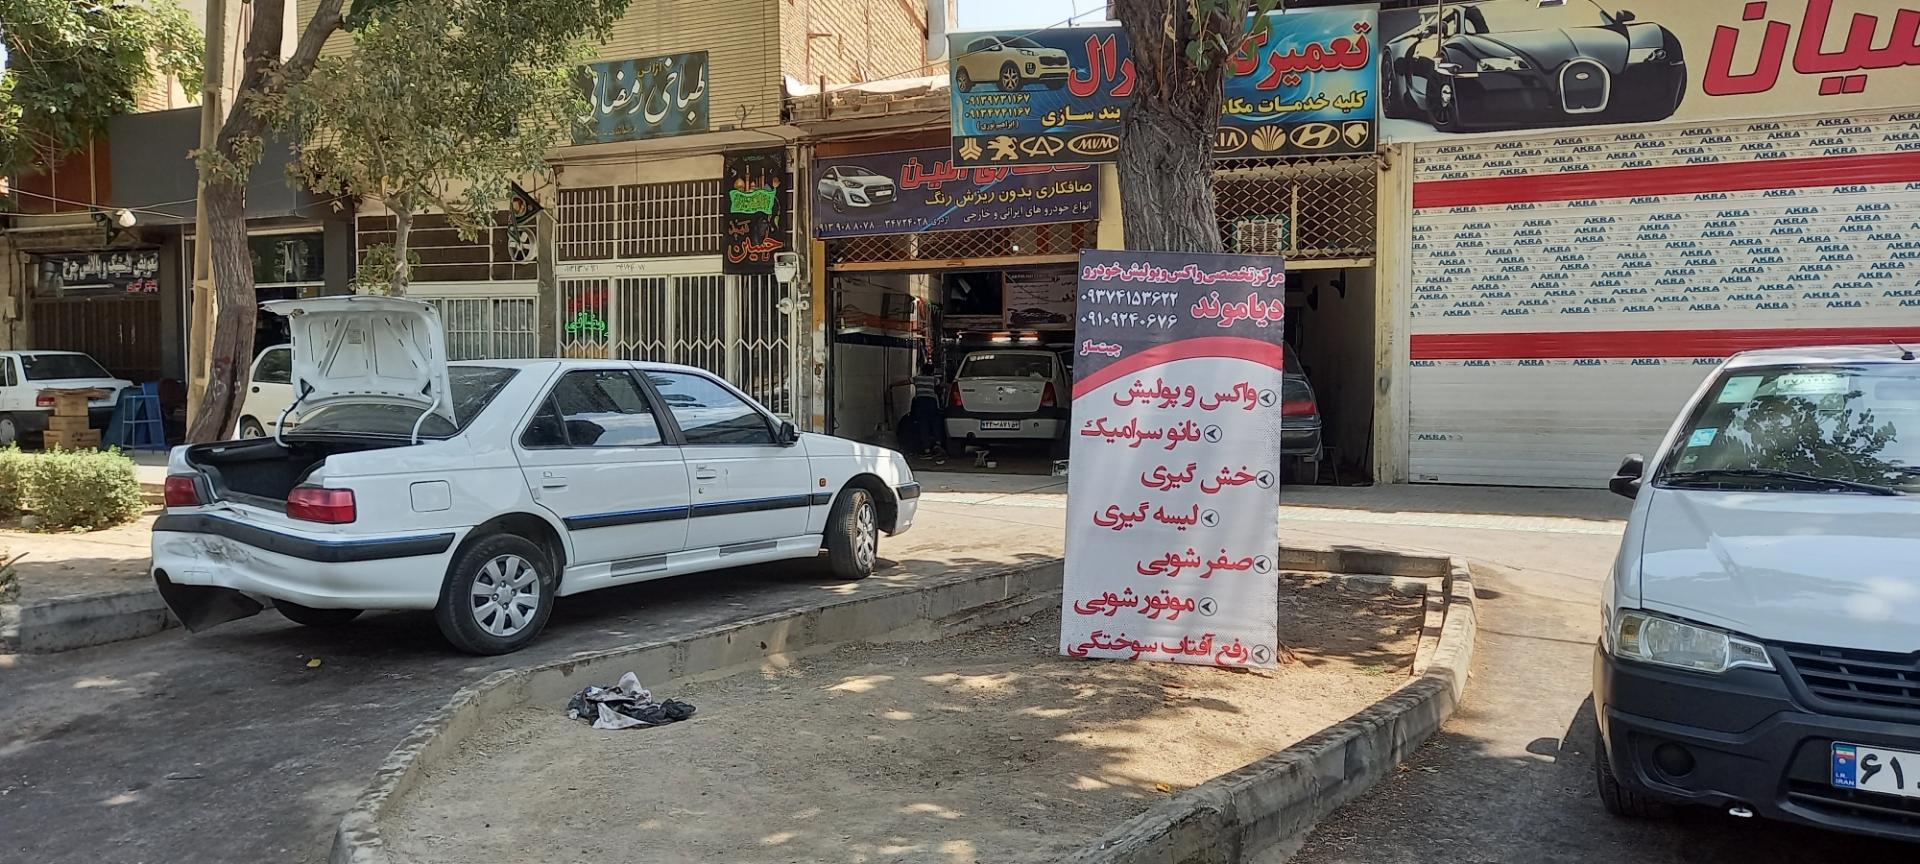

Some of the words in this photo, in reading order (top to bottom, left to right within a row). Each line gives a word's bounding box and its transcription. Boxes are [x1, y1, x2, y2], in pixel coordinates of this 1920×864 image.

[644, 57, 706, 125] طباخی
[1258, 91, 1329, 113] خدمات
[1333, 90, 1367, 113] کلیه
[1041, 105, 1094, 128] سازی
[1494, 142, 1524, 150] AKRA
[1615, 133, 1645, 141] AKRA
[1748, 123, 1780, 131] AKRA
[1816, 118, 1851, 127] AKRA
[1513, 149, 1542, 157] AKRA
[1767, 131, 1800, 140] AKRA
[1837, 126, 1872, 135] AKRA
[1078, 139, 1114, 151] MVM
[1483, 160, 1512, 168] AKRA
[1543, 156, 1574, 164] AKRA
[1740, 142, 1773, 151] AKRA
[1809, 138, 1844, 147] AKRA
[1882, 133, 1920, 142] AKRA
[1560, 164, 1589, 172] AKRA
[1754, 151, 1787, 160] AKRA
[1823, 147, 1858, 156] AKRA
[925, 191, 953, 207] رنگ
[956, 189, 995, 208] ریزش
[998, 187, 1032, 204] بدون
[1036, 180, 1092, 199] صافکاری
[1506, 203, 1535, 211] AKRA
[1763, 189, 1796, 197] AKRA
[1832, 186, 1867, 194] AKRA
[963, 208, 991, 223] خارجی
[999, 206, 1023, 220] ایرانی
[1025, 204, 1042, 218] های
[1044, 205, 1069, 217] خودرو
[1072, 201, 1092, 215] انواع
[1717, 209, 1750, 218] AKRA
[1785, 206, 1818, 215] AKRA
[1856, 203, 1891, 212] AKRA
[1774, 217, 1809, 225] AKRA
[1845, 214, 1881, 223] AKRA
[1575, 235, 1604, 243] AKRA
[1770, 227, 1803, 235] AKRA
[1838, 224, 1873, 232] AKRA
[1729, 238, 1763, 246] AKRA
[1798, 235, 1831, 244] AKRA
[1867, 233, 1901, 241] AKRA
[727, 236, 784, 263] حسین
[1555, 254, 1584, 262] AKRA
[1747, 247, 1780, 255] AKRA
[1815, 244, 1850, 252] AKRA
[1685, 258, 1717, 266] AKRA
[1752, 256, 1784, 264] AKRA
[1819, 254, 1854, 262] AKRA
[1081, 261, 1123, 281] خودرو
[1122, 262, 1160, 283] پولیش
[1166, 264, 1204, 284] واکس
[1203, 265, 1256, 285] تخصصی
[1254, 267, 1285, 287] مرکز
[1481, 274, 1510, 282] AKRA
[1799, 264, 1832, 272] AKRA
[1870, 261, 1906, 270] AKRA
[1857, 271, 1893, 280] AKRA
[1080, 288, 1179, 307] ۰۹۳۷۴۱۵۳۶۲۲
[1544, 289, 1576, 297] AKRA
[1684, 285, 1720, 293] AKRA
[1758, 283, 1794, 291] AKRA
[1833, 281, 1871, 290] AKRA
[1654, 295, 1689, 303] AKRA
[1727, 293, 1763, 301] AKRA
[1803, 291, 1839, 299] AKRA
[1191, 290, 1285, 328] دیاموند
[1561, 306, 1590, 314] AKRA
[1689, 303, 1721, 311] AKRA
[1755, 302, 1789, 310] AKRA
[1826, 300, 1862, 308] AKRA
[1080, 310, 1178, 329] ۰۹۱۰۹۲۴۰۶۷۶
[1113, 378, 1180, 409] پولیش
[1182, 387, 1195, 408] و
[1199, 382, 1257, 411] واکس
[1080, 416, 1163, 448] سرامیک
[1166, 420, 1201, 450] نانو
[1418, 433, 1447, 441] AKRA
[1140, 462, 1197, 492] گیری
[1200, 465, 1257, 494] خش
[1093, 502, 1150, 531] گیری
[1153, 503, 1199, 531] لیسه
[1200, 548, 1254, 579] صفر
[1138, 589, 1195, 620] موتور
[1067, 630, 1158, 661] سوختگی
[1161, 633, 1216, 662] آفتاب
[1215, 638, 1249, 665] رفع
[1860, 753, 1905, 790] ۶۱
[1835, 778, 1855, 786] IRAN
